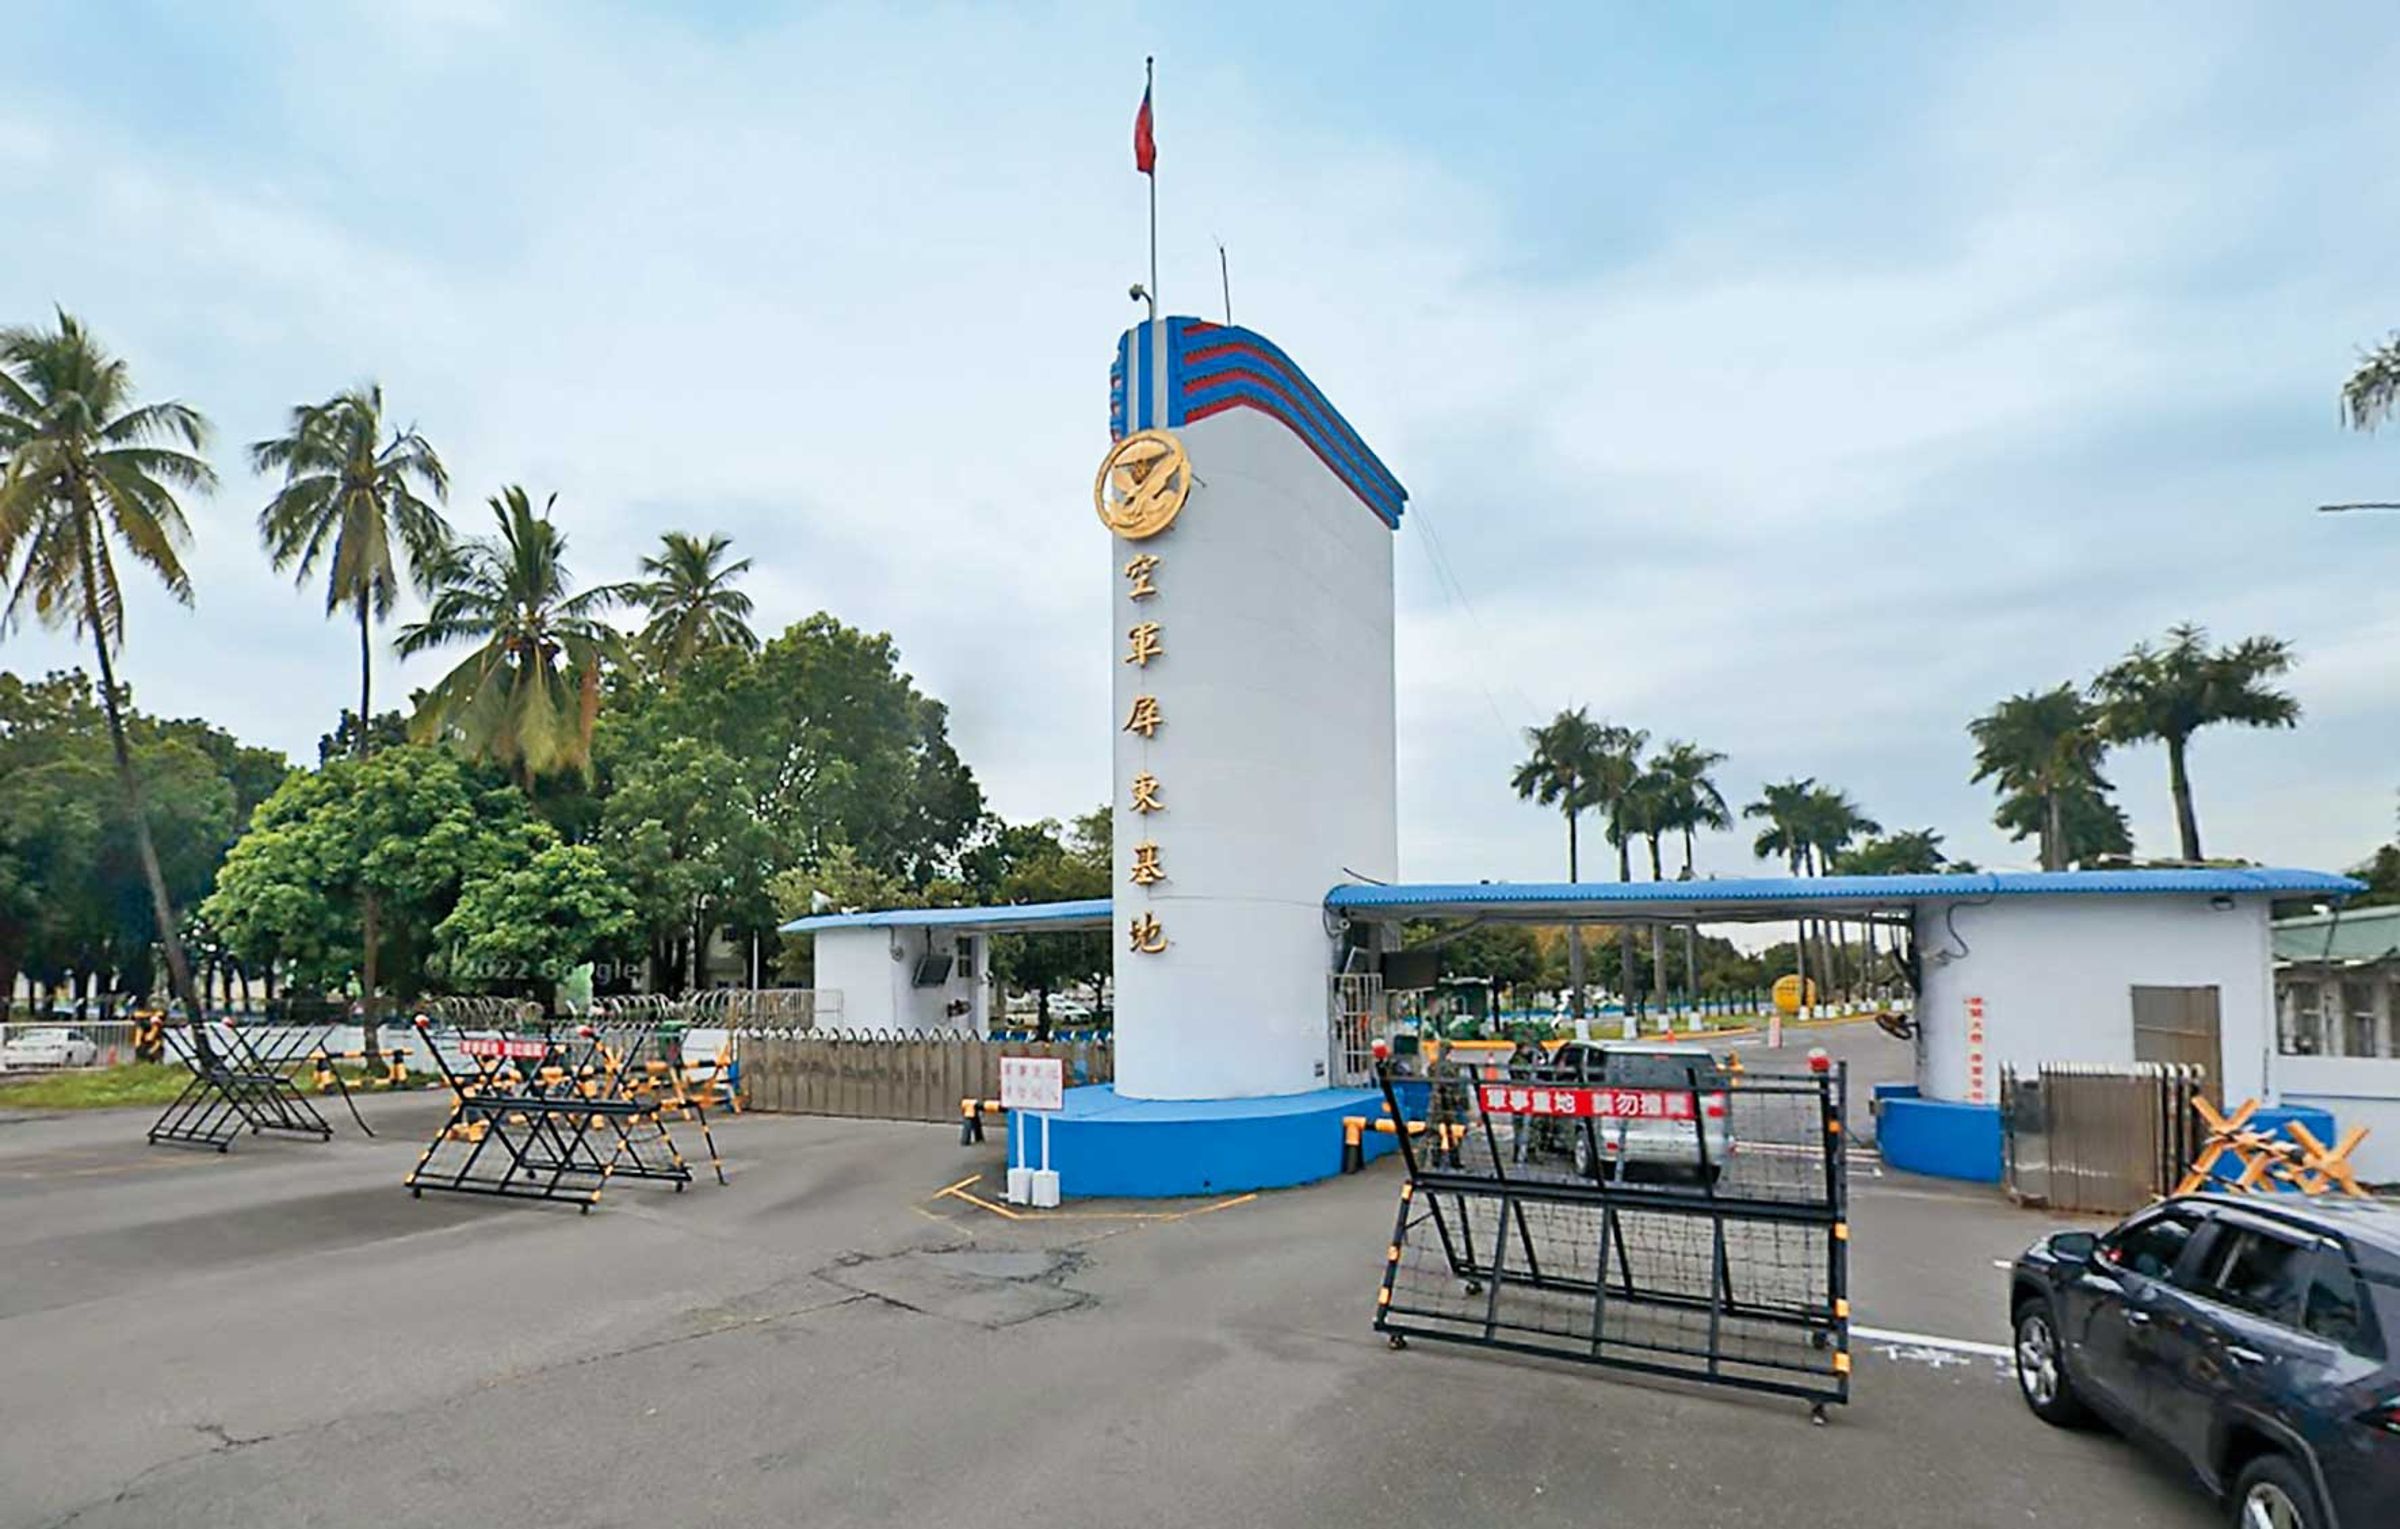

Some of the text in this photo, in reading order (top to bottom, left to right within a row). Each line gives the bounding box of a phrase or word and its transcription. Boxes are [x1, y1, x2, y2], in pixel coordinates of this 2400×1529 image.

[1123, 553, 1169, 954] 空軍屏東基地
